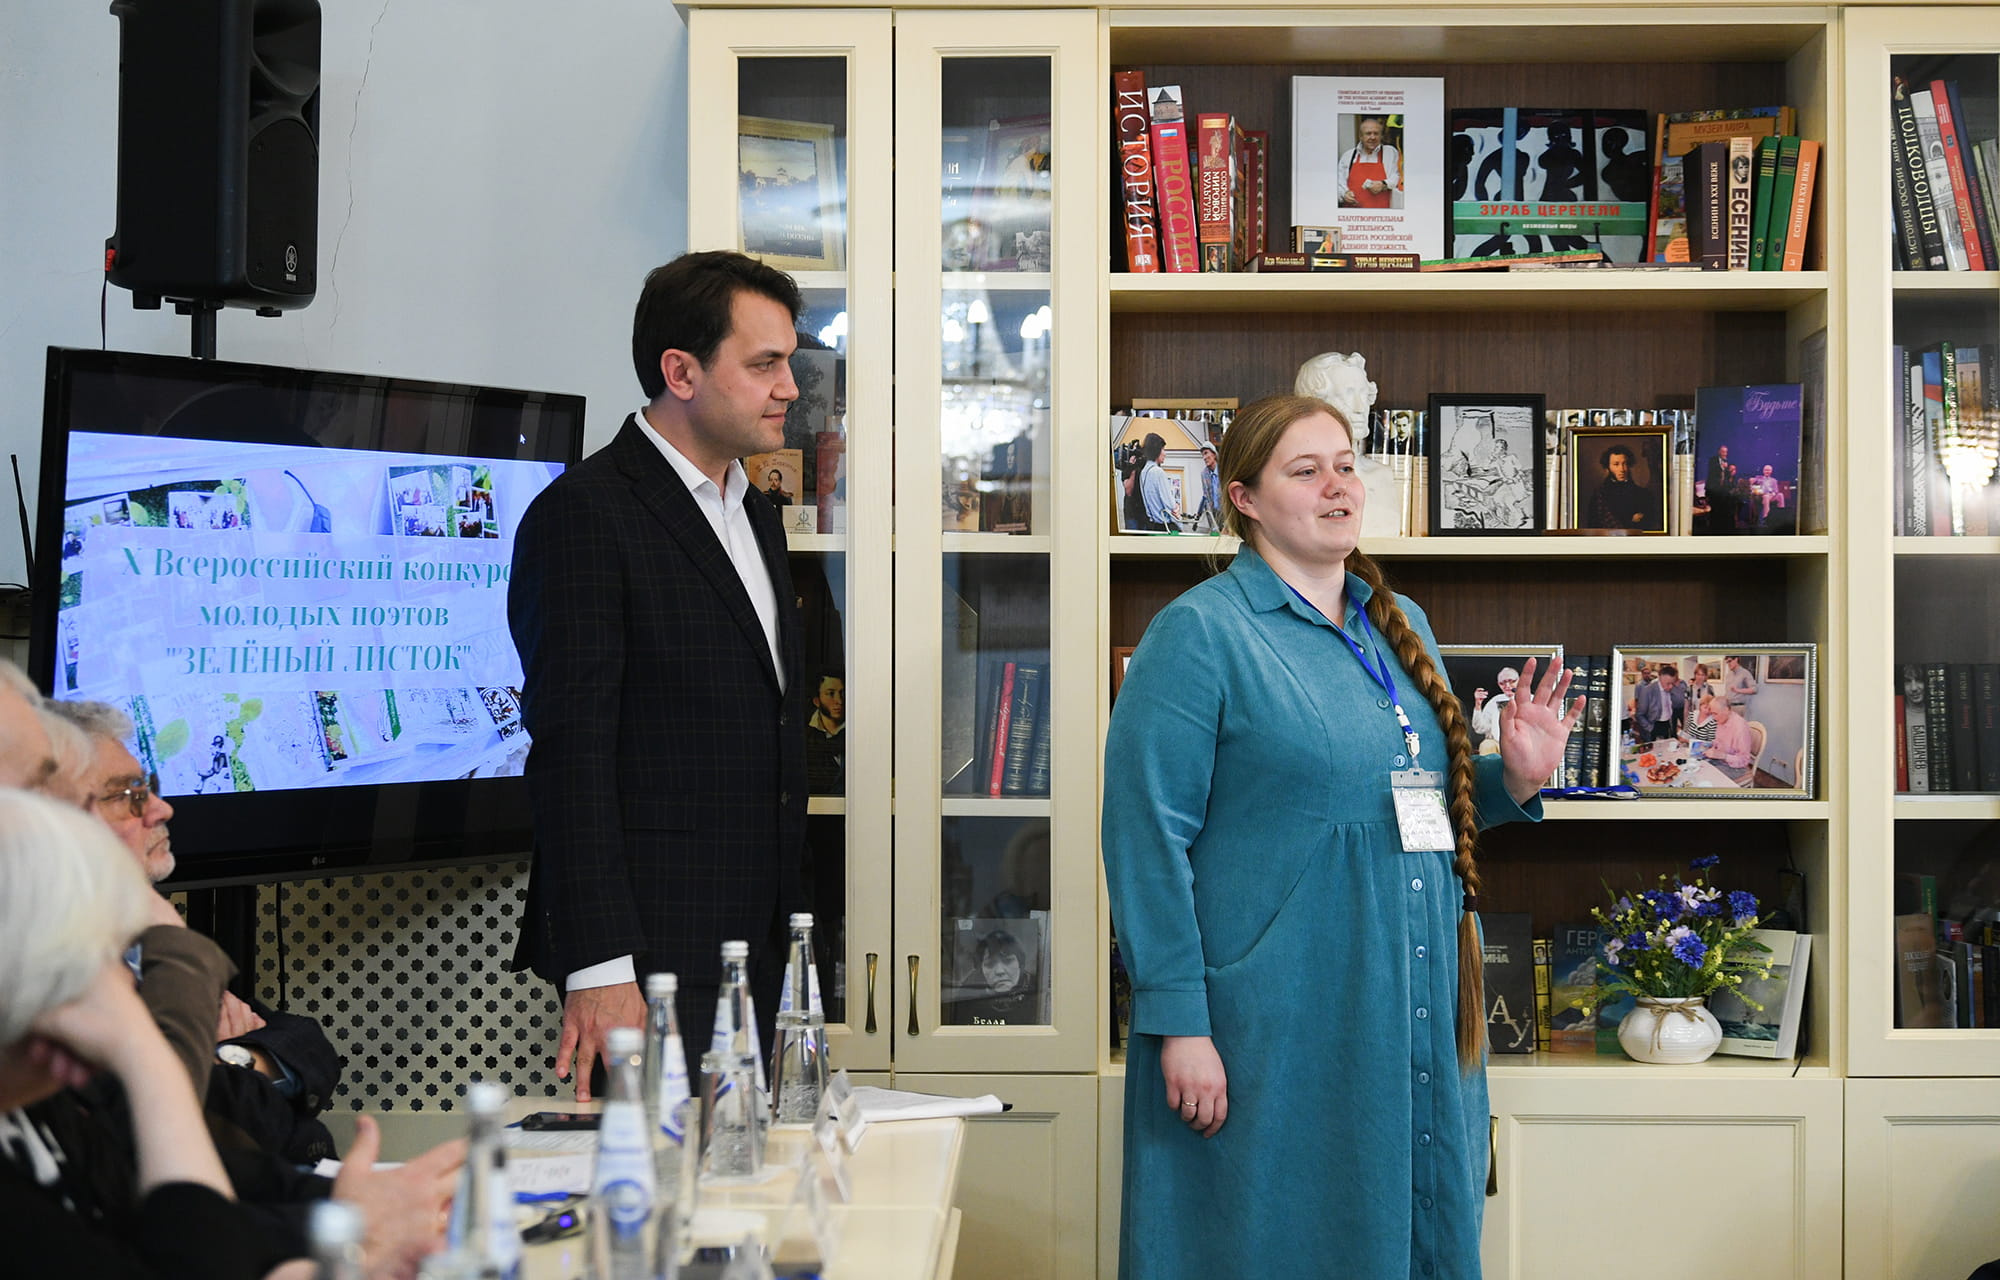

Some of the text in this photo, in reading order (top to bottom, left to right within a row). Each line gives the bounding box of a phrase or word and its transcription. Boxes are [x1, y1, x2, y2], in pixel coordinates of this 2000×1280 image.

[1725, 122, 1750, 133] МИРА
[1118, 89, 1153, 240] ИСТОРИЯ
[1711, 162, 1719, 182] ВЕКЕ
[1898, 108, 1938, 235] ПОЛКОВОДЦЫ
[1203, 171, 1212, 222] КУЛЬТУРЫ
[1211, 171, 1221, 222] МИРОВОЙ
[1220, 171, 1228, 221] СОКРОВИЩА
[1711, 184, 1719, 198] XXI
[1793, 204, 1806, 238] ЕСЕНИН
[1801, 162, 1811, 182] ВЕКЕ
[1160, 158, 1195, 270] РОССИЯ
[1480, 204, 1620, 217] ЗУРАБ ЦЕРЕТЕЛИ
[1711, 206, 1719, 240] ЕСЕНИН
[1731, 188, 1749, 268] ЕСЕНИН
[1894, 167, 1917, 254] ИСТОРИЯ РОССИИ
[1370, 233, 1413, 241] РОССИЙСКОЙ
[1712, 261, 1719, 269] 4
[155, 548, 393, 585] Всероссийский
[198, 605, 449, 631] молодых поэтов
[166, 639, 472, 675] "ЗЕЛЁНЫЙ ЛИСТОК"
[1912, 724, 1927, 770] БАШЛАЧЕВ
[973, 1016, 1006, 1026] Белла
